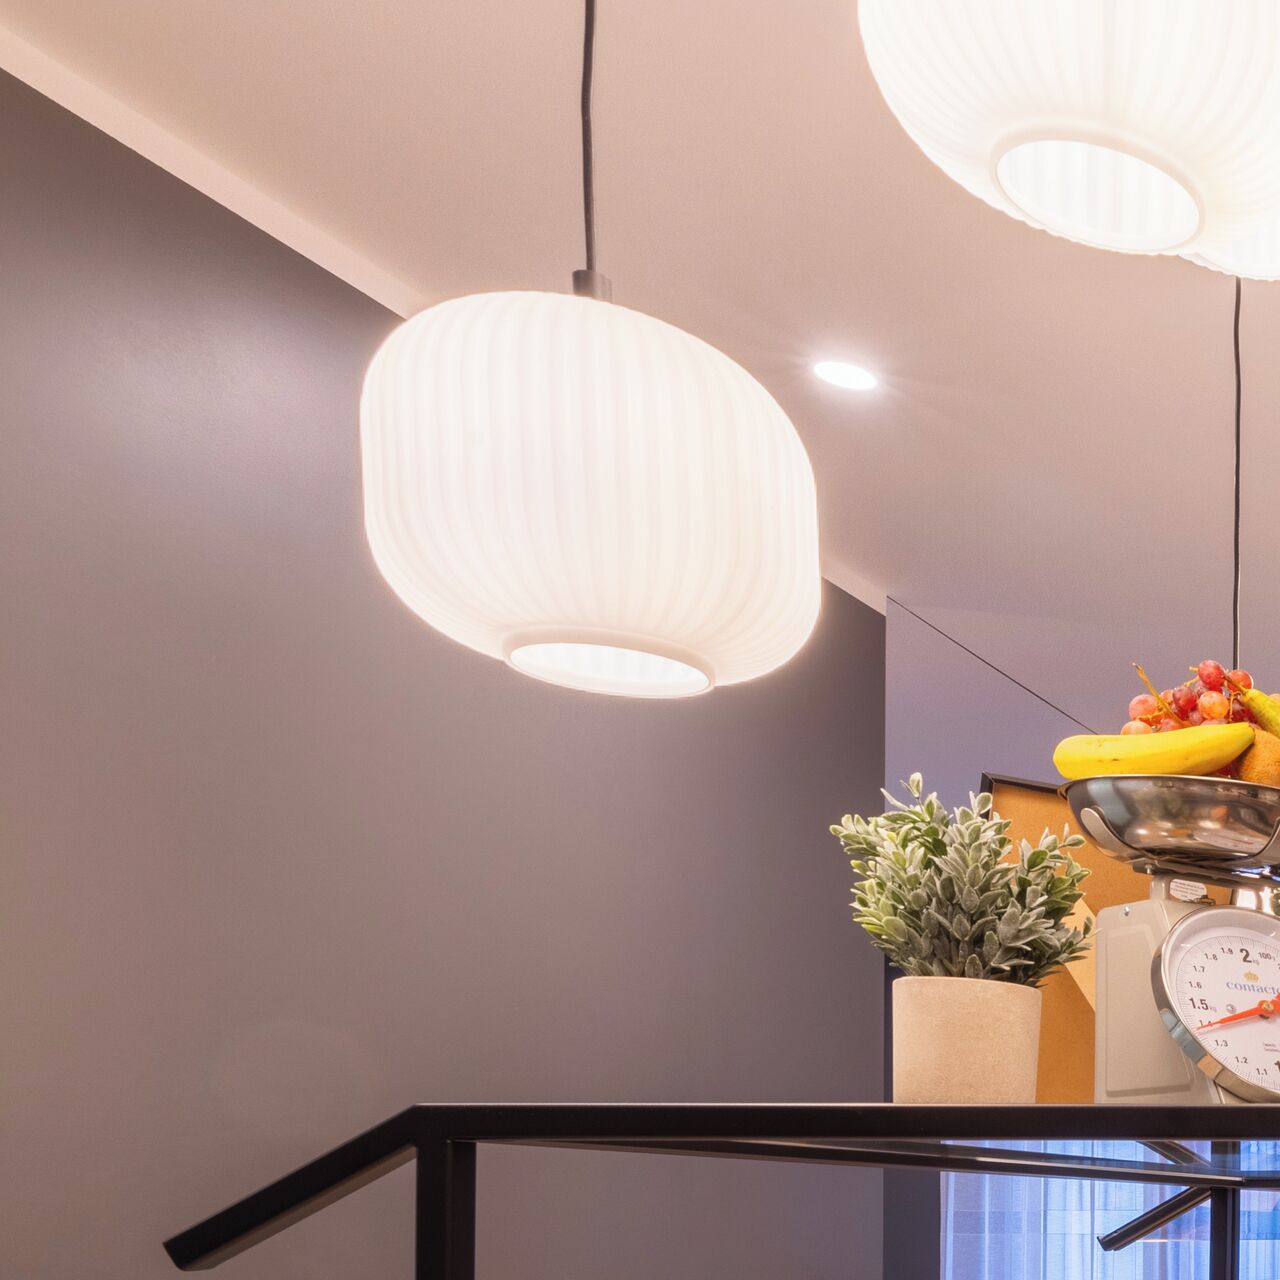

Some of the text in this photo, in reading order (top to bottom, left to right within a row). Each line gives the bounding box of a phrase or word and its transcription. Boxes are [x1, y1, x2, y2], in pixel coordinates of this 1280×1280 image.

[1221, 947, 1234, 955] 1.9
[1204, 953, 1218, 961] 1.8
[1193, 965, 1206, 973] 1.7
[1189, 981, 1202, 989] 1.6
[1215, 1039, 1229, 1047] 1.3
[1235, 1056, 1248, 1064] 1.2
[1256, 1068, 1268, 1076] 1.1
